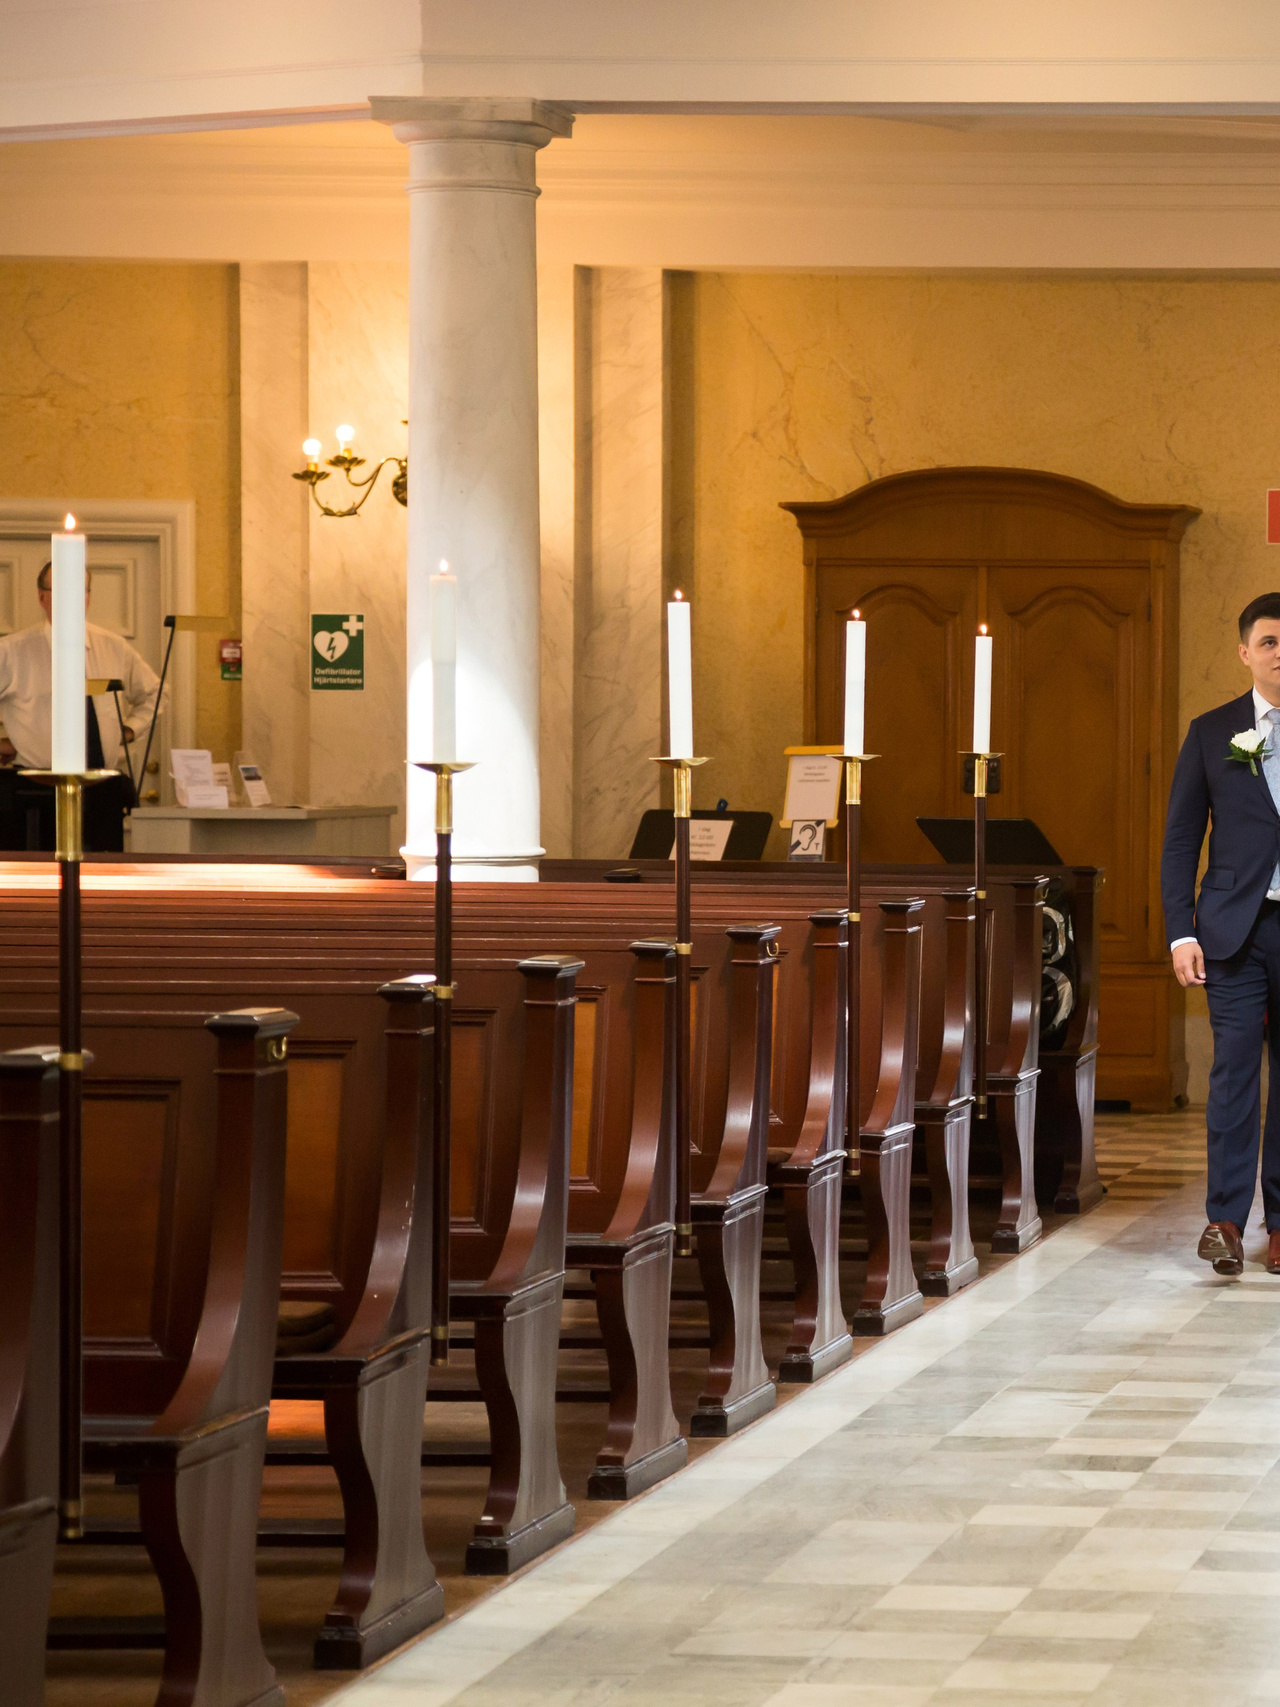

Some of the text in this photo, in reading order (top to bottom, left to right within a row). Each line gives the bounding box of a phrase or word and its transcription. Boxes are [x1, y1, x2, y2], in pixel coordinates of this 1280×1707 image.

[315, 668, 361, 676] Defibrillator
[313, 676, 362, 685] Hjärtstartare
[814, 842, 820, 850] T
